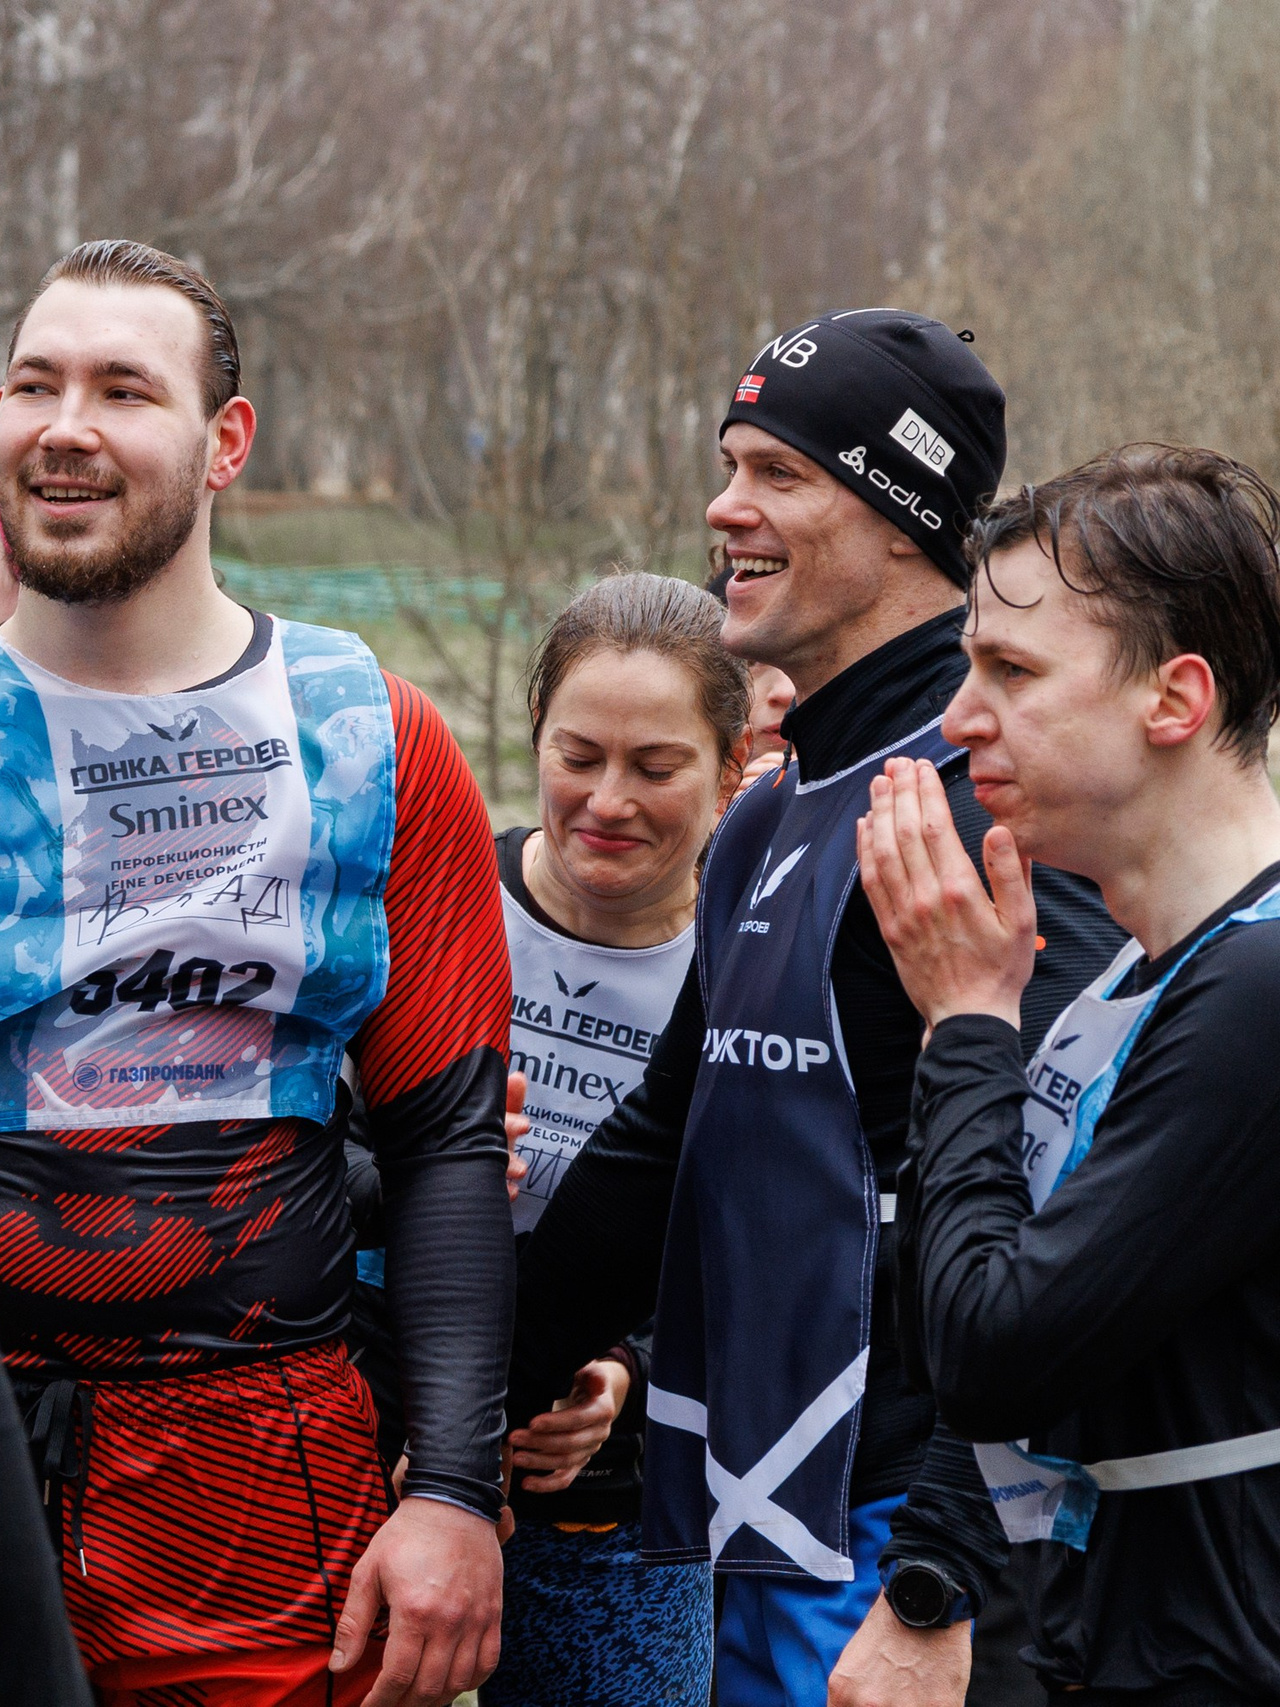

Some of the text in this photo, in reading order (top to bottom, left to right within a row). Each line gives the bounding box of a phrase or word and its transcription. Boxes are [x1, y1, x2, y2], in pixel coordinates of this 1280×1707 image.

[749, 324, 819, 371] NB
[901, 420, 946, 466] DNB
[868, 468, 942, 530] odlo
[70, 738, 290, 787] ГОНКА ГЕРОЕВ
[109, 795, 269, 838] Sminex
[110, 838, 267, 871] ПЕРФЕКЦИОНИСТЫ
[111, 853, 267, 891] FINE DEVELOPMENT
[109, 1063, 225, 1084] ГАЗПРОМБАНК
